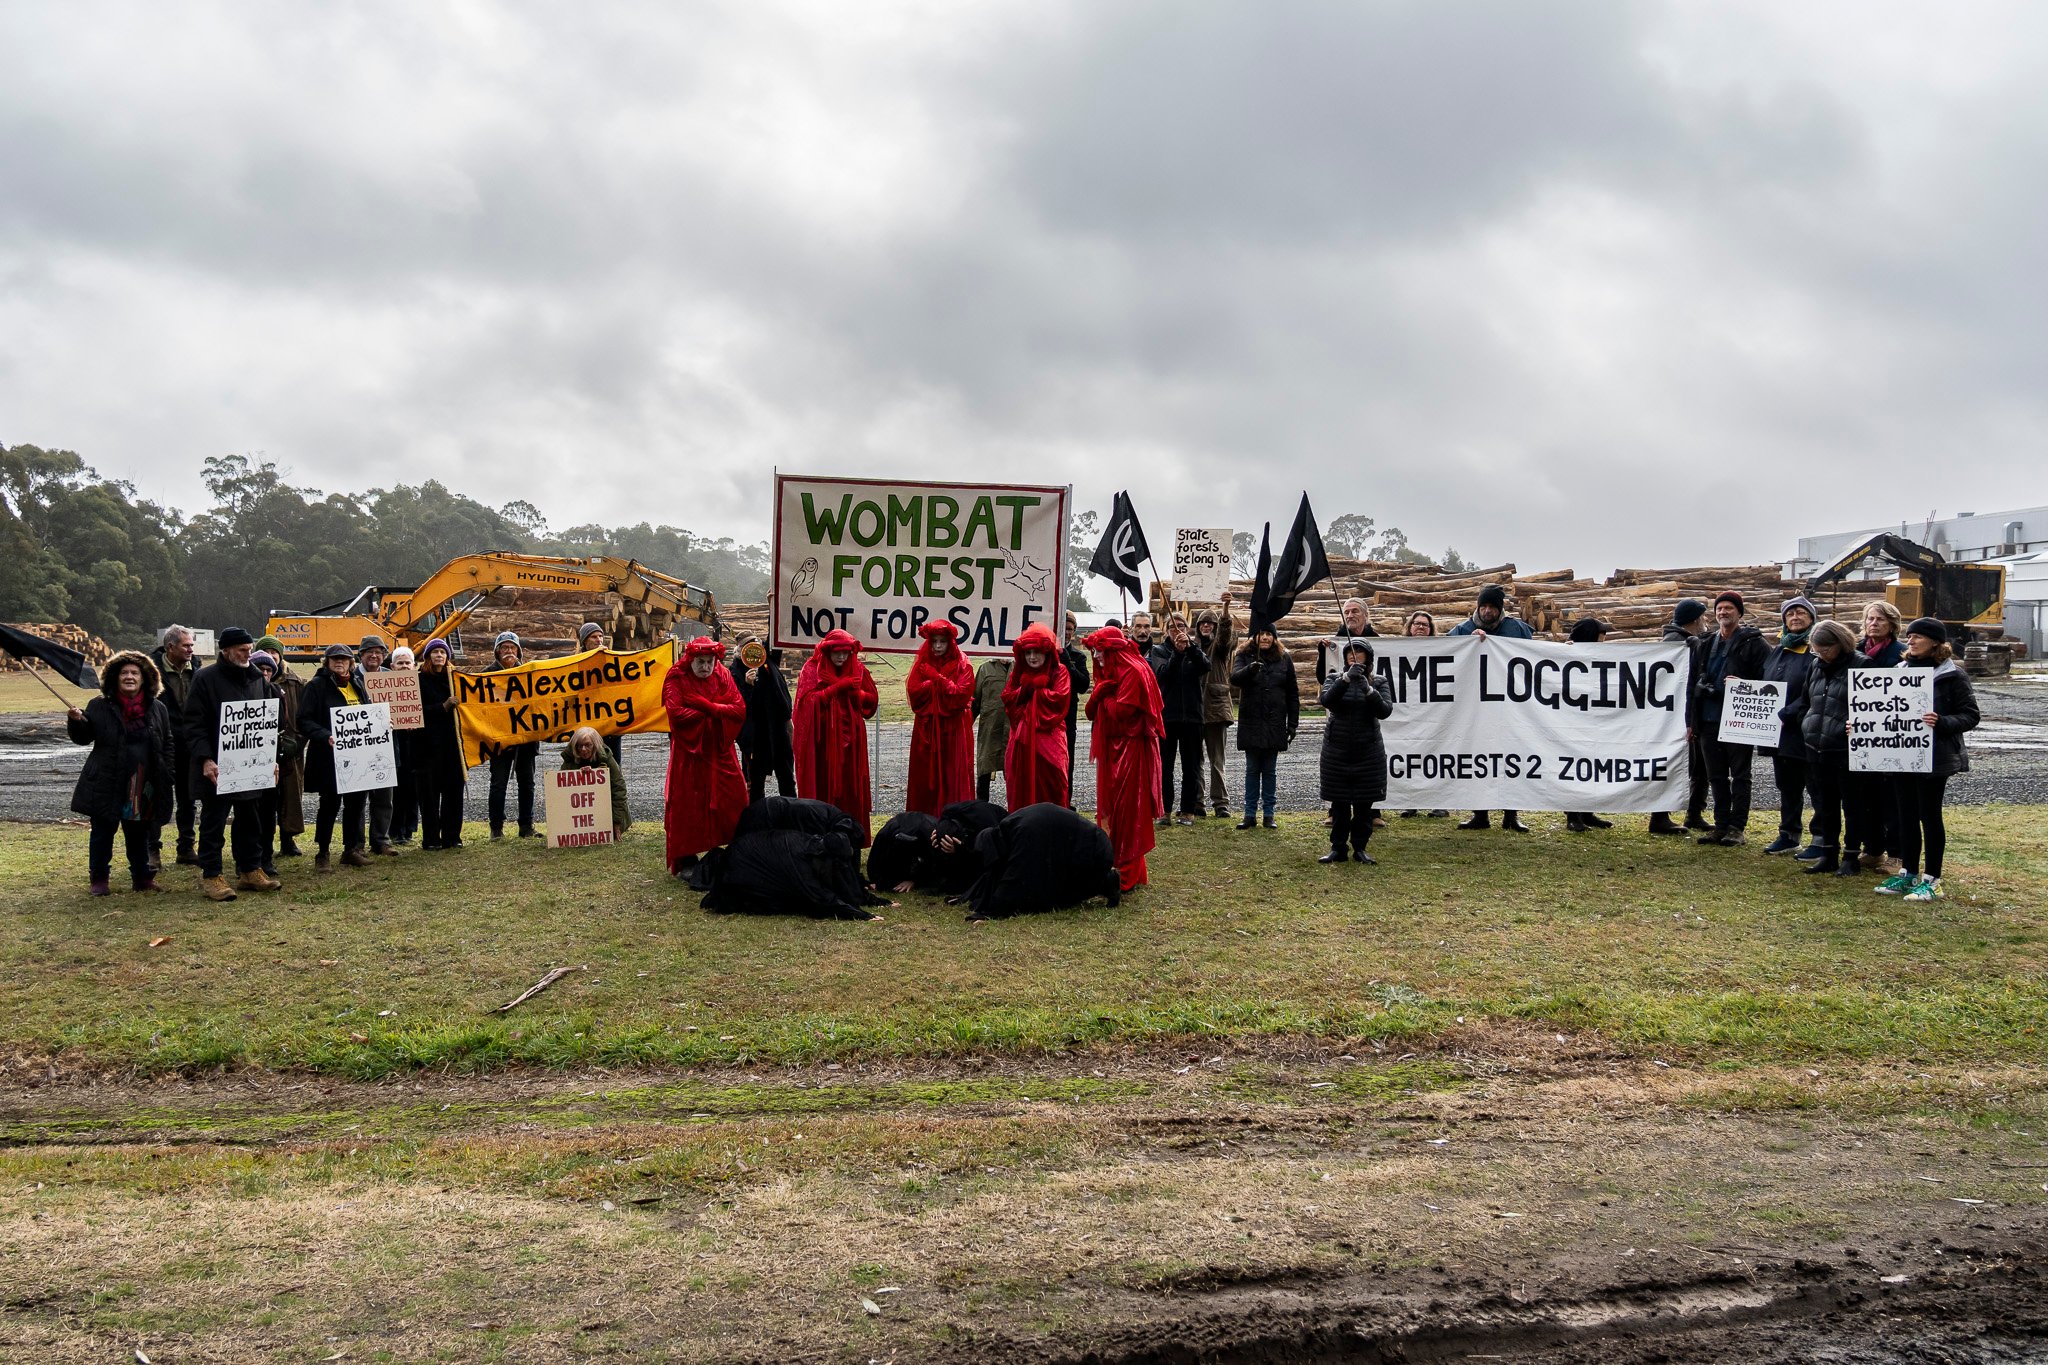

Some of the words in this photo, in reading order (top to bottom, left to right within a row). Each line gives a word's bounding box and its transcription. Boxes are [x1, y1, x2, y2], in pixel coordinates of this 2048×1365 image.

[801, 493, 1041, 550] WOMBAT
[1178, 529, 1209, 540] State
[1177, 540, 1219, 553] forests
[1176, 552, 1214, 568] belong
[1217, 553, 1229, 563] to
[832, 555, 1005, 599] FOREST
[1175, 565, 1188, 574] us
[517, 572, 580, 585] HYUNDAI
[276, 624, 310, 632] ANC
[791, 605, 854, 638] NOT
[871, 606, 929, 640] FOR
[366, 676, 415, 690] CREATURES
[460, 676, 500, 703] Mt.
[505, 657, 657, 701] Alexander
[1376, 656, 1454, 703] AME
[1478, 653, 1674, 711] LOGGING
[1853, 671, 1893, 694] Keep
[1899, 675, 1925, 688] our
[372, 691, 393, 703] LIVE
[396, 690, 418, 701] HERE
[1732, 696, 1776, 706] PROTECT
[1850, 695, 1910, 712] forests
[225, 701, 267, 723] Protect
[509, 696, 635, 734] Knitting
[1732, 703, 1775, 713] WOMBAT
[1734, 711, 1770, 720] FOREST
[335, 709, 368, 725] Save
[396, 715, 421, 725] HOMES!
[1852, 717, 1876, 733] for
[1881, 714, 1923, 732] future
[221, 723, 242, 736] our
[243, 718, 278, 735] precious
[335, 721, 373, 738] Wombat
[1746, 722, 1777, 731] FORESTS
[222, 732, 264, 751] wildlife
[336, 734, 362, 751] State
[364, 729, 390, 745] Forest
[1850, 733, 1930, 752] generations
[557, 769, 606, 787] HANDS
[1558, 756, 1668, 783] ZOMBIE
[571, 792, 595, 808] OFF
[572, 814, 595, 828] THE
[557, 831, 612, 848] WOMBAT
